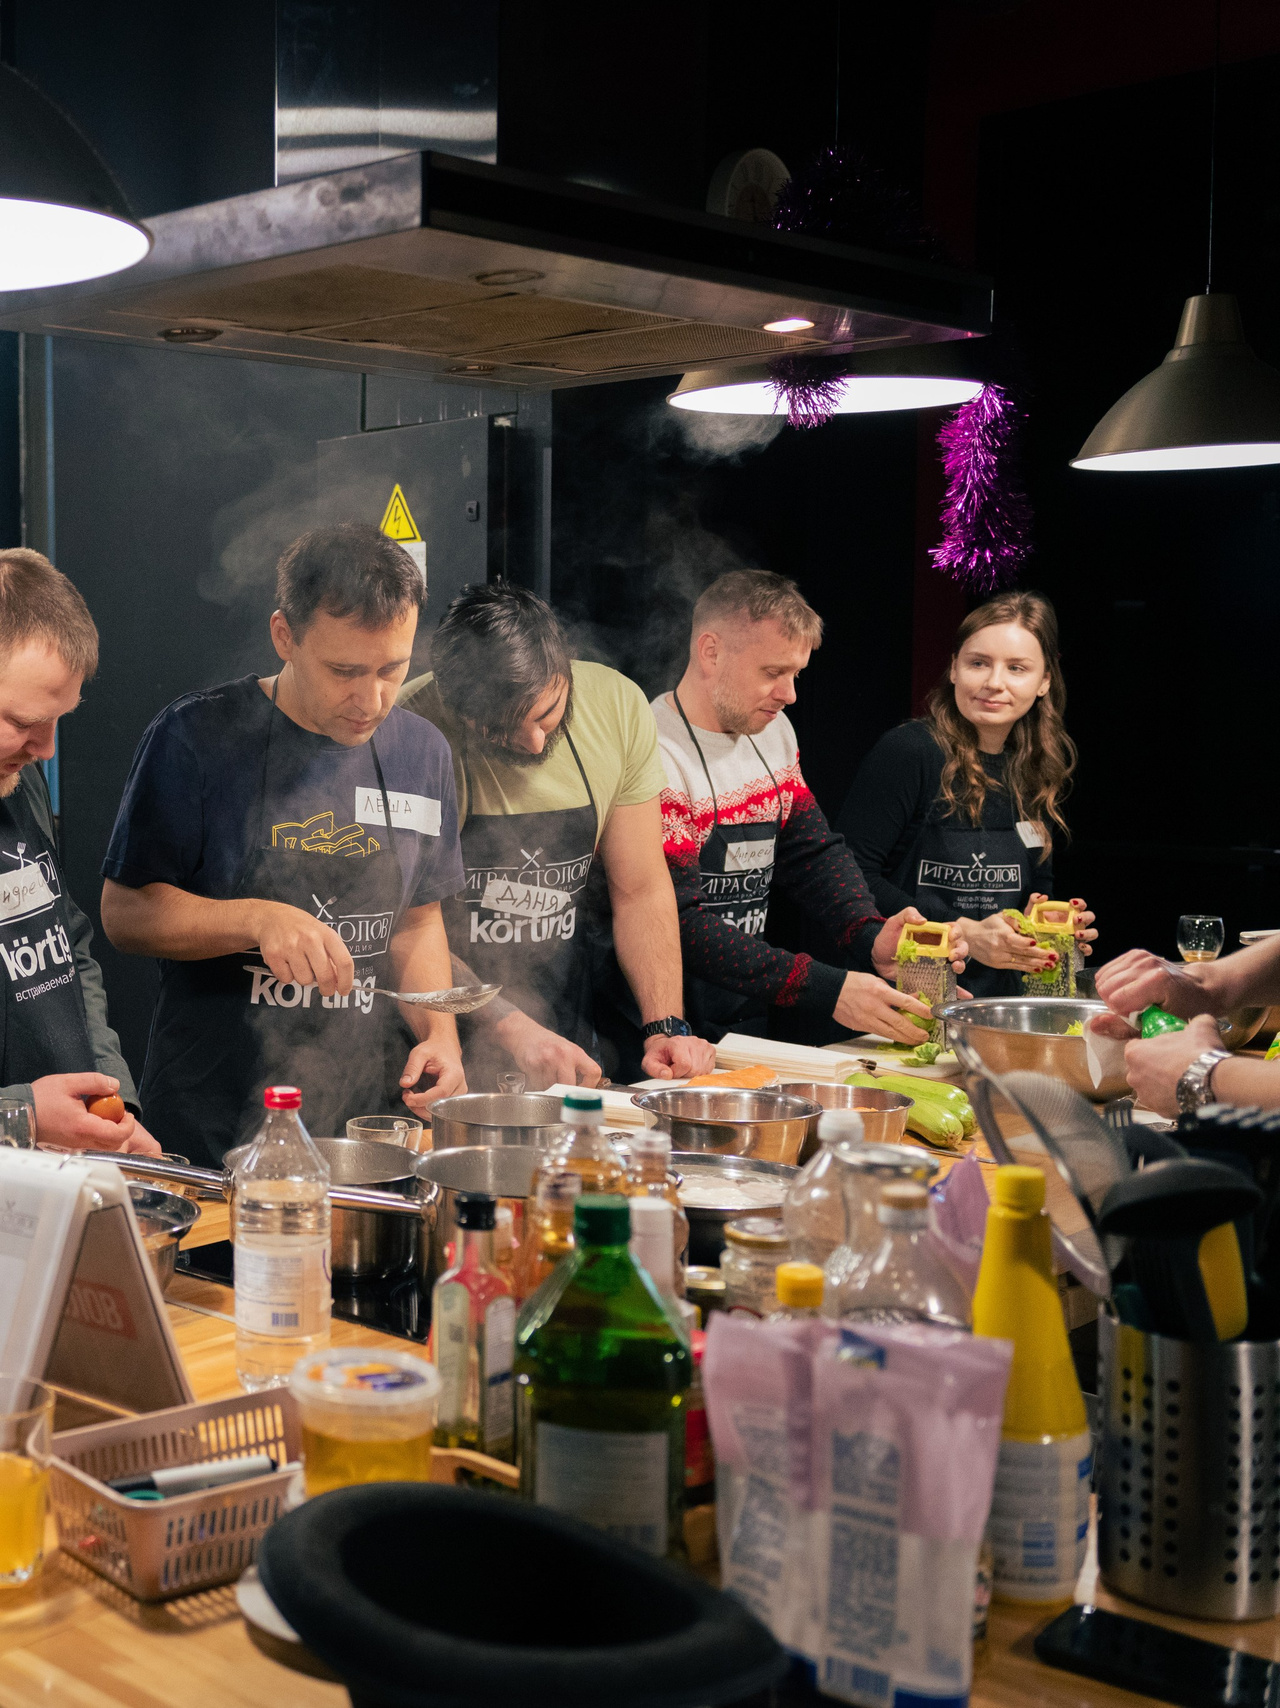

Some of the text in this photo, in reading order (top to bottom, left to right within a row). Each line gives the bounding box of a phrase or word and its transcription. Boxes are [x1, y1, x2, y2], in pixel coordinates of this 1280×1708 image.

[518, 860, 589, 887] СТОЛОВ
[743, 868, 774, 892] СТО
[923, 863, 1018, 883] ИГРА СТОЛОВ
[495, 885, 559, 912] ДАНЯ
[323, 917, 389, 942] ТОЛОВ
[470, 907, 576, 944] körting
